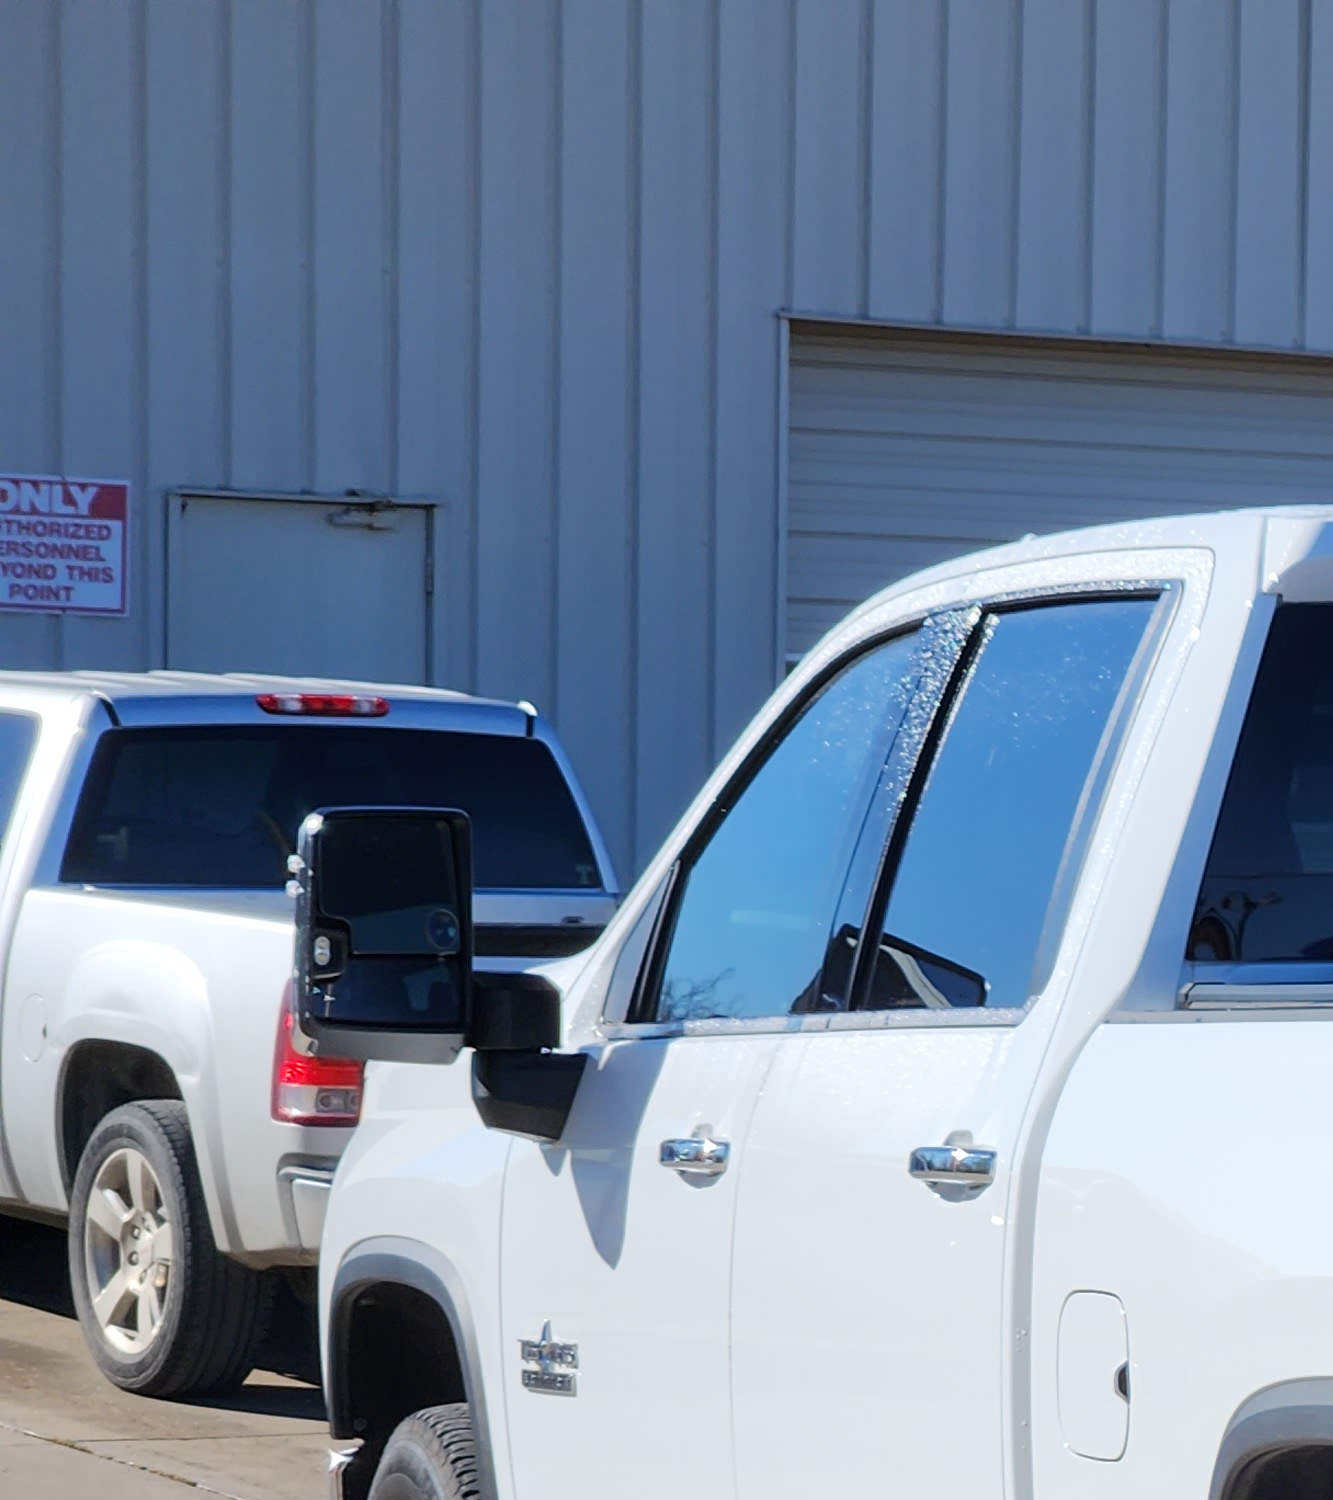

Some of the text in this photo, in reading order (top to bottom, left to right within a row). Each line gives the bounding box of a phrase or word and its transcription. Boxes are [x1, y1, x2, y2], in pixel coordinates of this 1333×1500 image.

[0, 480, 98, 515] ONLY
[0, 519, 112, 541] THORIZED
[66, 565, 113, 583] THIS
[9, 584, 74, 601] POINT
